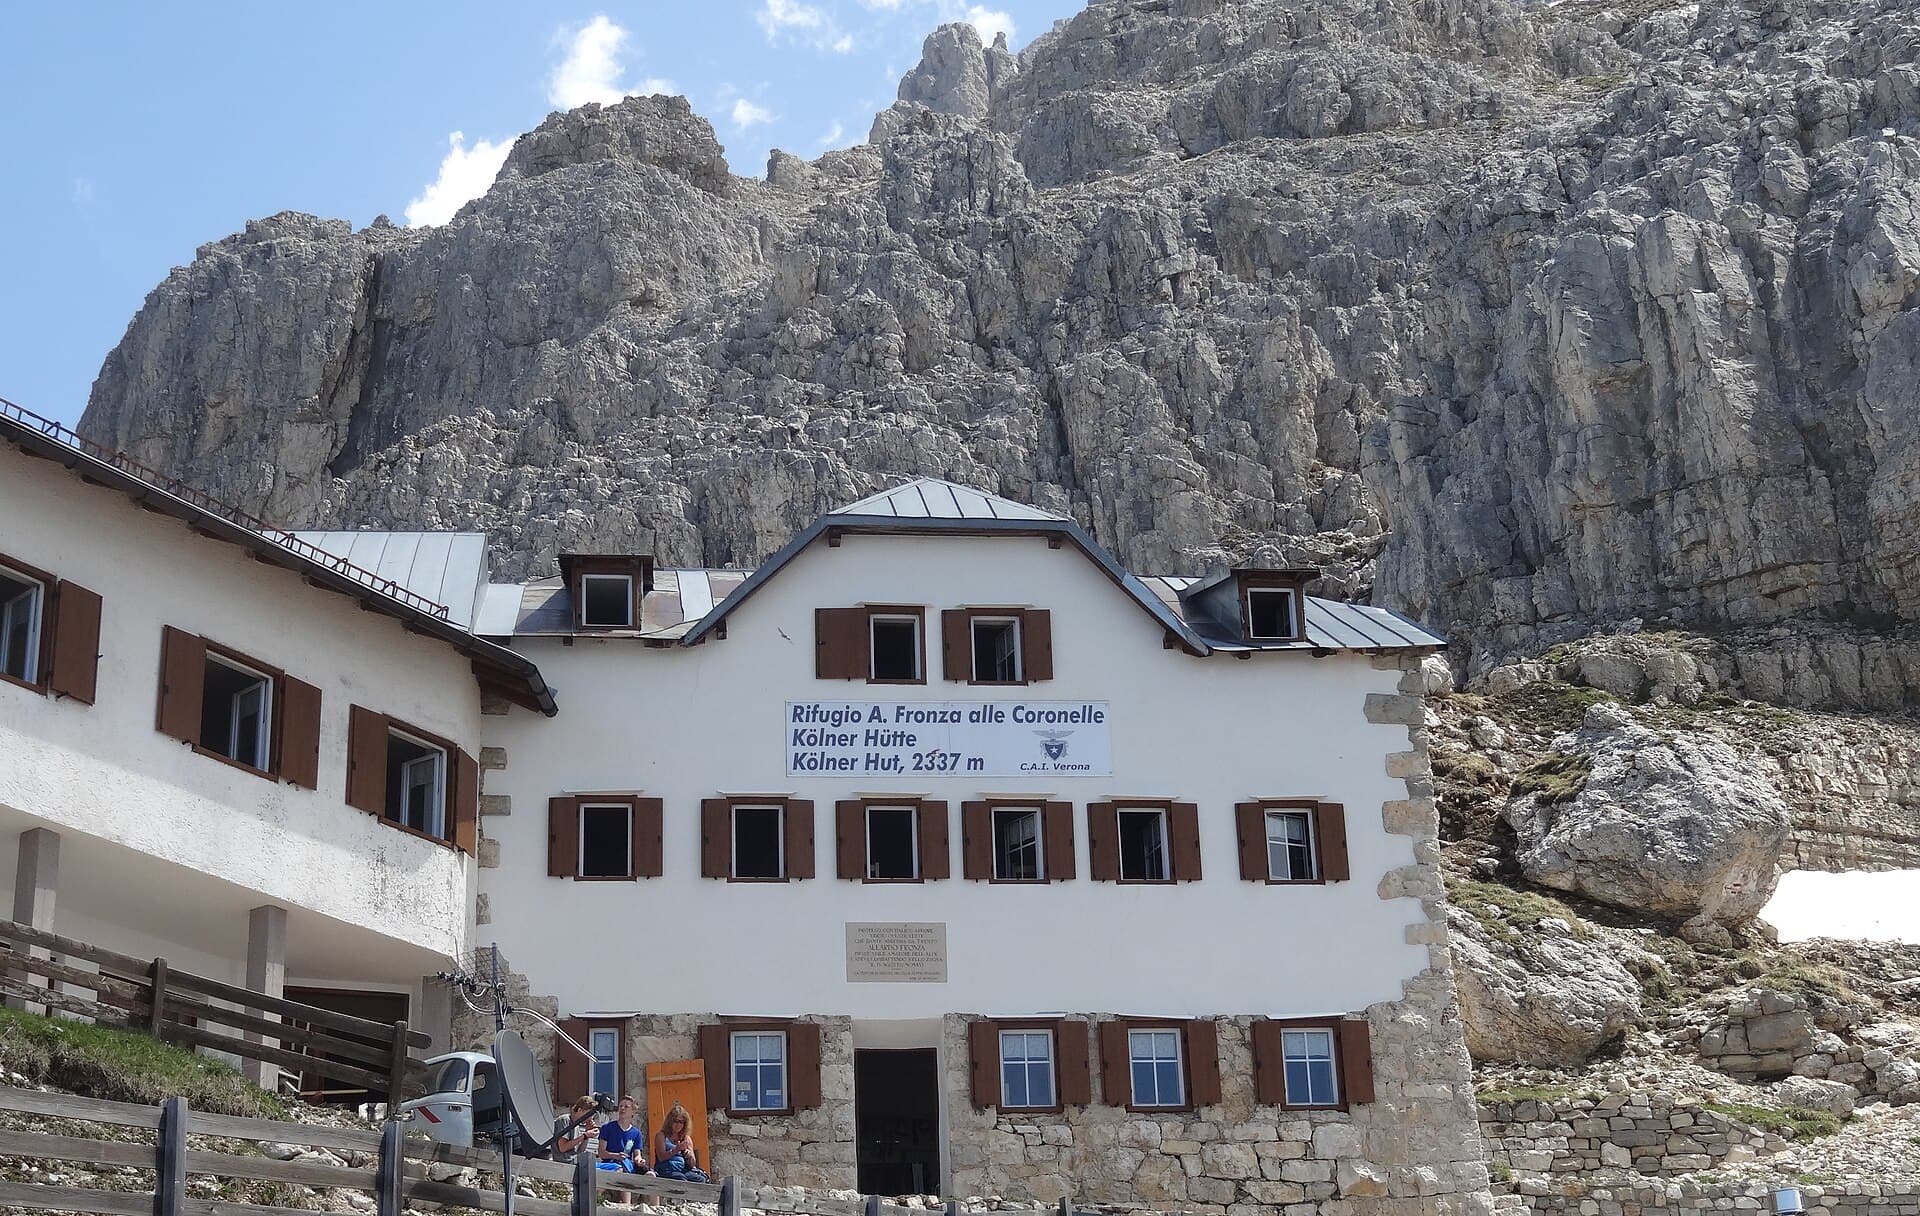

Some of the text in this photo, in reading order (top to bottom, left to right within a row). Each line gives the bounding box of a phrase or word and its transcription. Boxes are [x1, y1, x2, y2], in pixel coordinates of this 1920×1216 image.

[792, 704, 1105, 727] Rifugio A. Fronza alle Coronelle
[792, 728, 917, 747] Kölner Hütte
[792, 752, 984, 774] Kölner Hut, 2337 m
[1020, 762, 1090, 771] C.A.I. Verona
